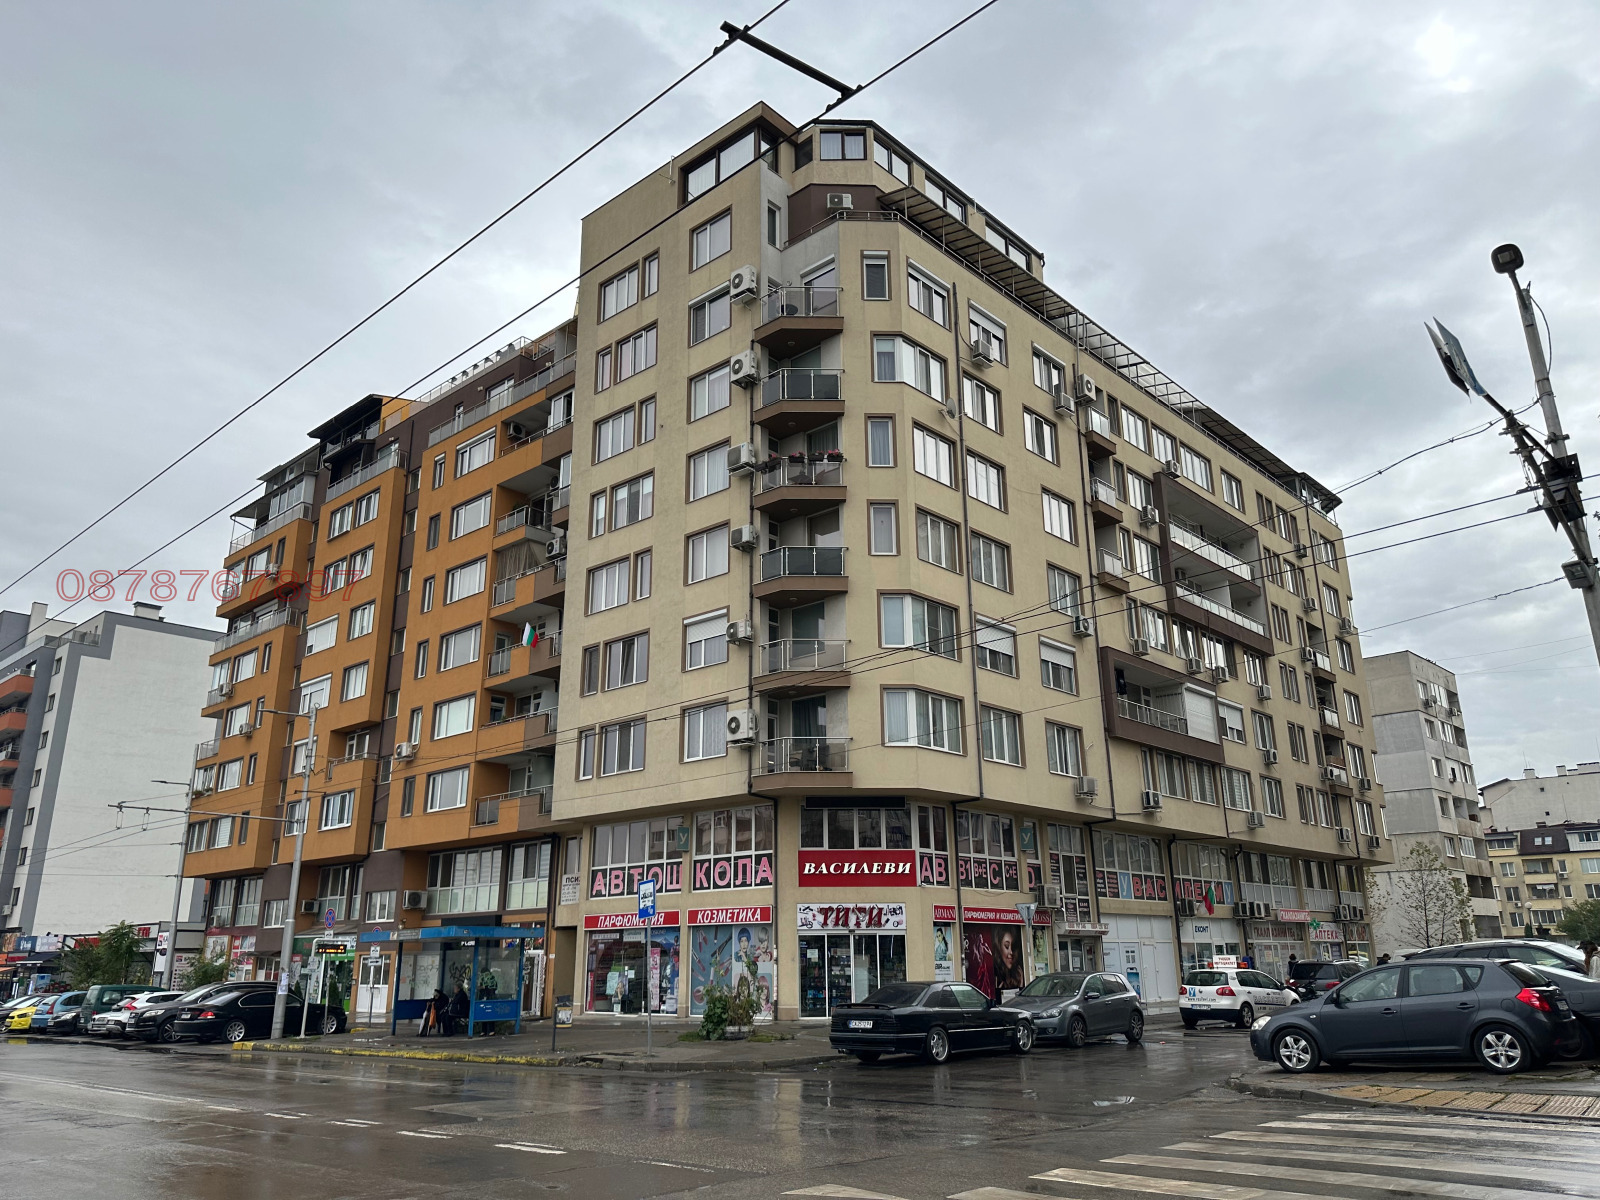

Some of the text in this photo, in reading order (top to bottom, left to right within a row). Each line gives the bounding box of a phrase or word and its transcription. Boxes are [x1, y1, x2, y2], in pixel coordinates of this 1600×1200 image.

[803, 862, 912, 875] ВАСИЛЕВИ
[974, 862, 988, 878] B+E
[1005, 865, 1018, 879] C+E
[696, 908, 761, 923] КОЗМЕТИКА
[934, 908, 956, 920] ARMANI
[964, 910, 996, 920] ПАРФЮМЕРИЯ
[1033, 912, 1051, 923] BOSS
[1194, 925, 1209, 933] ЕКОНТ
[1314, 929, 1339, 940] АПТЕКА
